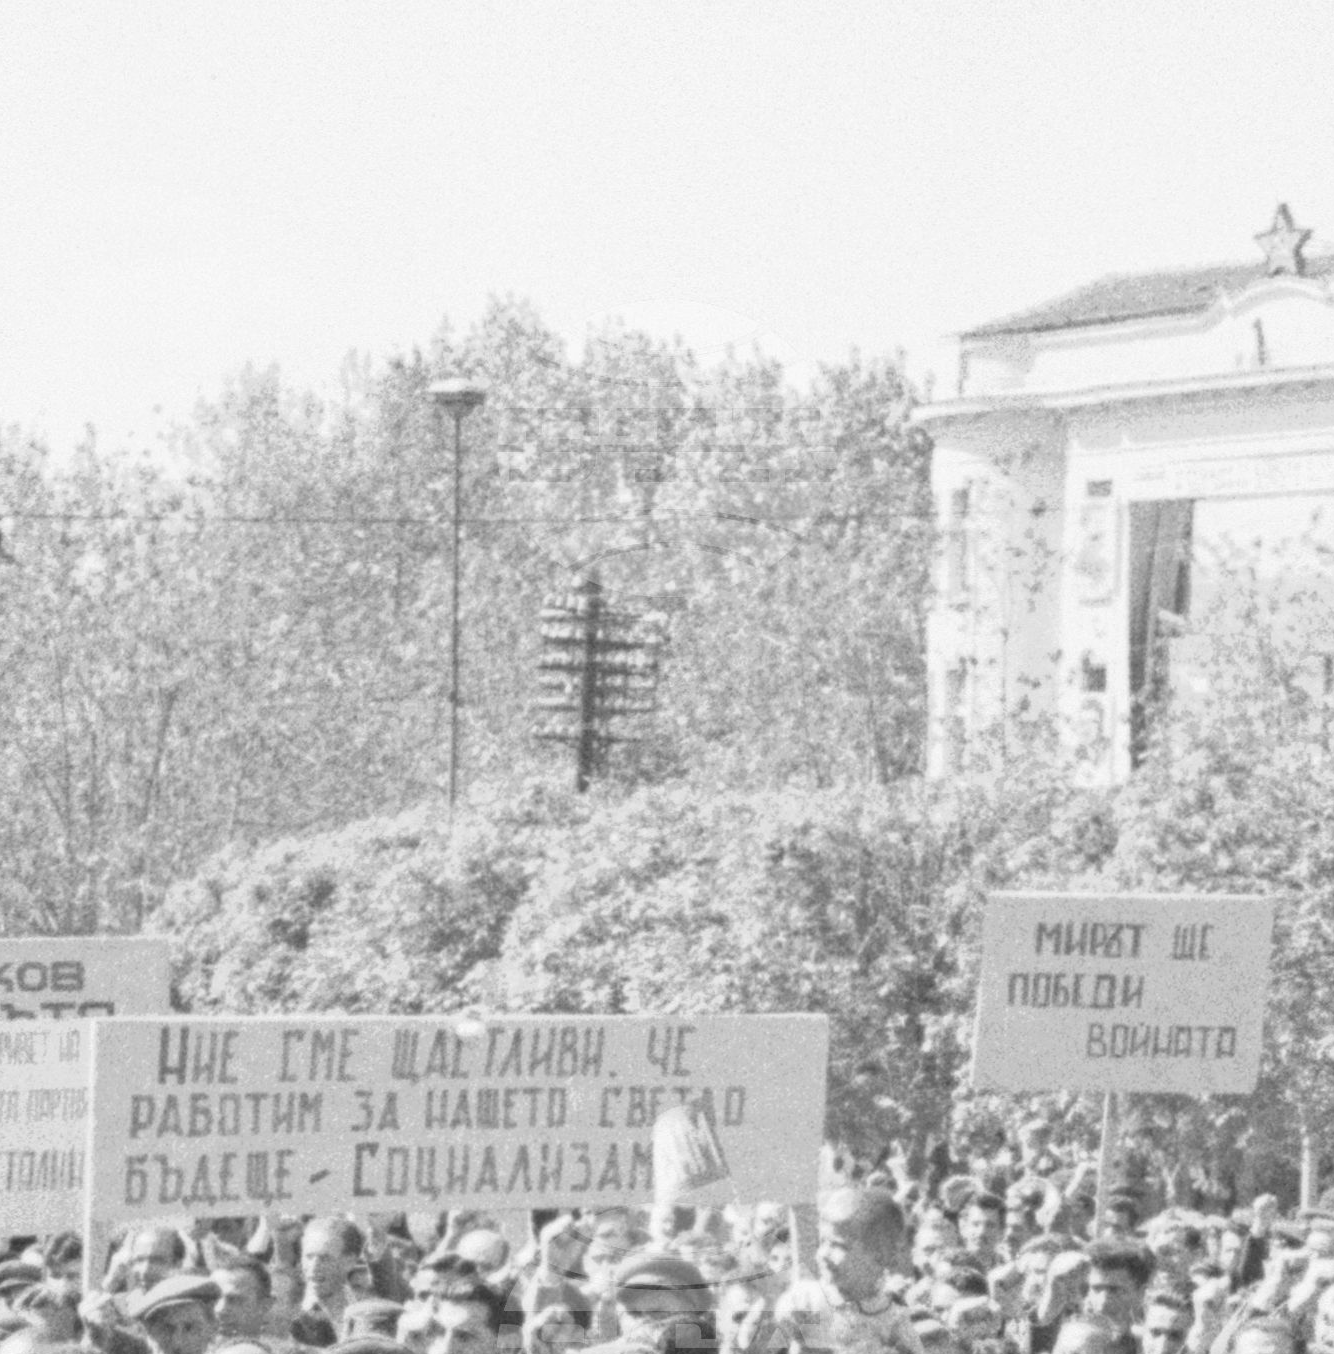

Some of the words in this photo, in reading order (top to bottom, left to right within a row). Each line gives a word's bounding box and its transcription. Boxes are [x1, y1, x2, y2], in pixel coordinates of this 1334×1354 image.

[1008, 972, 1145, 1009] ПОБЕДИ
[157, 1025, 240, 1086] НИЕ
[278, 1028, 360, 1083] СМЕ
[646, 1025, 697, 1078] ЧЕ
[1087, 1021, 1237, 1059] ВОЙНАТА
[129, 1090, 323, 1138] РАБОТИМ
[350, 1089, 401, 1132] ЗА
[424, 1086, 567, 1131] НАШЕТО
[123, 1150, 294, 1207] БЪДЕЩЕ
